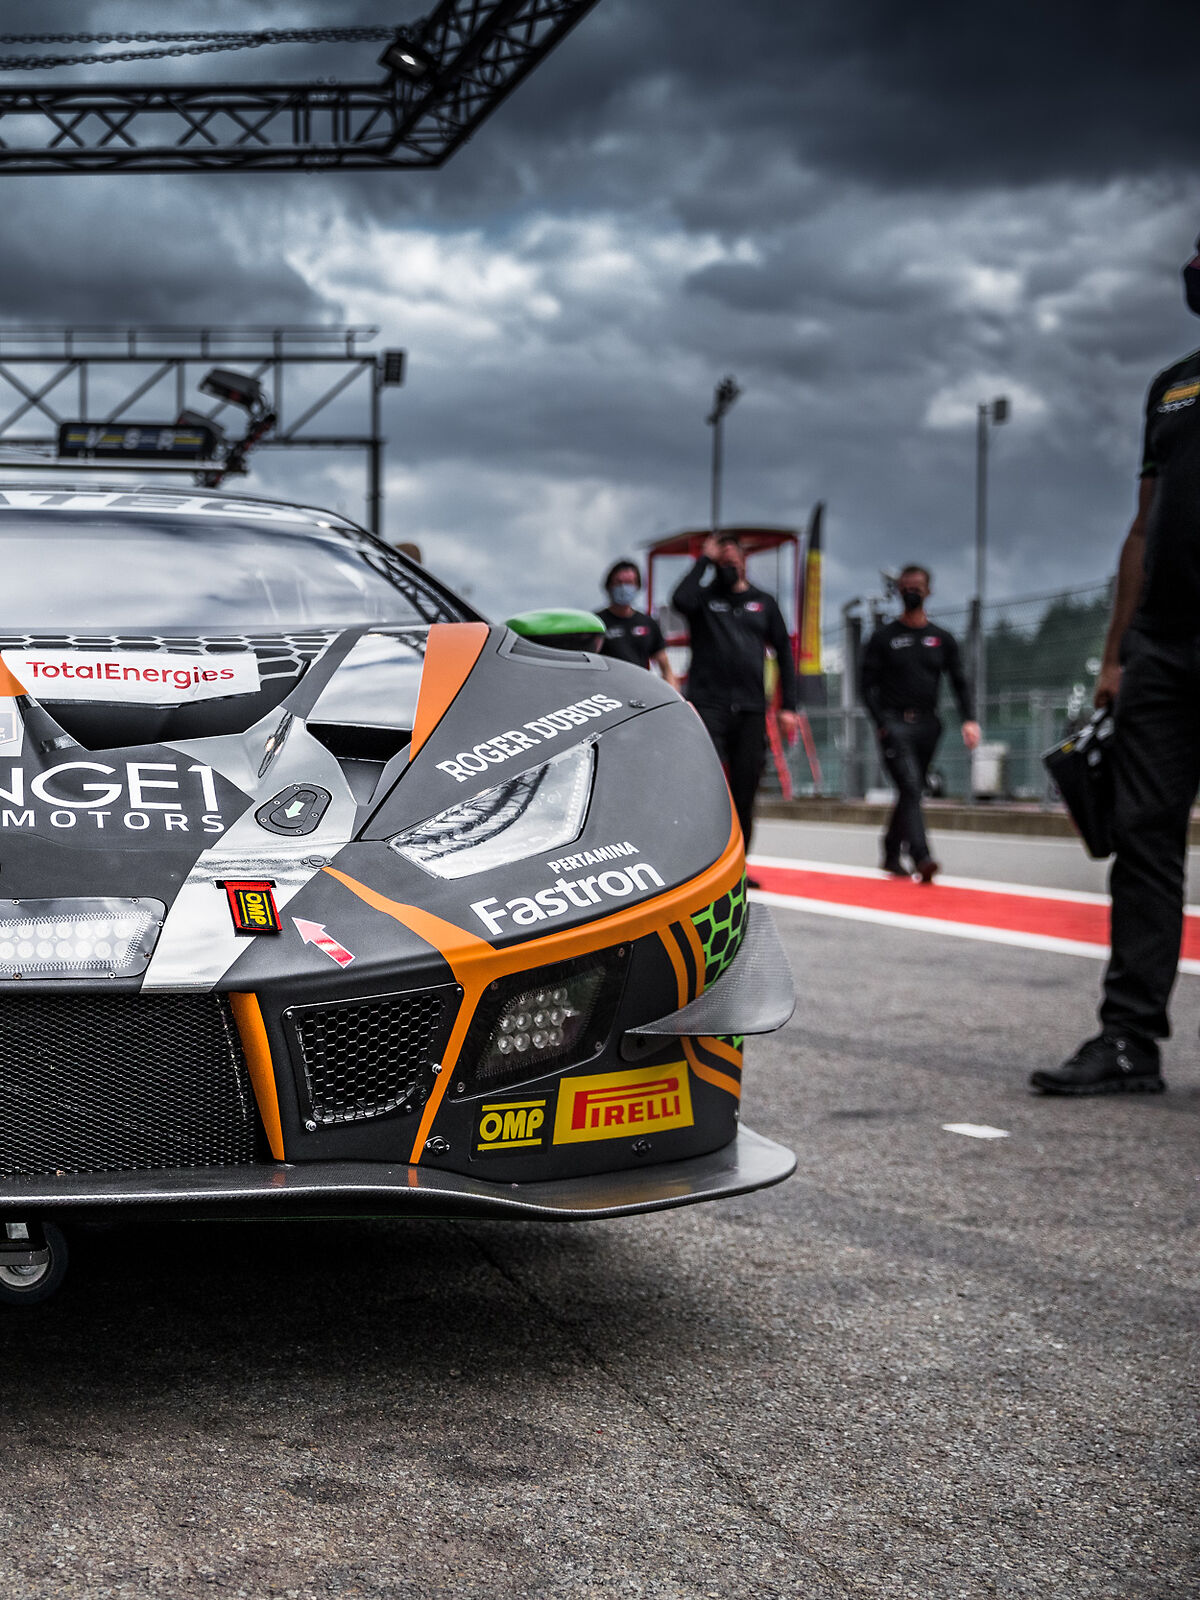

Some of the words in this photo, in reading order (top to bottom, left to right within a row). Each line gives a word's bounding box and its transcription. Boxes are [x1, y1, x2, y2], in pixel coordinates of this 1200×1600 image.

[26, 662, 235, 689] TotalEnergies
[435, 730, 542, 783] ROGER
[523, 693, 623, 740] DUBUIS
[1, 809, 226, 834] MOTORS
[547, 841, 640, 874] PERTAMINA
[245, 892, 267, 926] OMP
[469, 862, 666, 936] Fastron
[570, 1077, 681, 1131] PIRELLI
[478, 1107, 545, 1142] OMP
